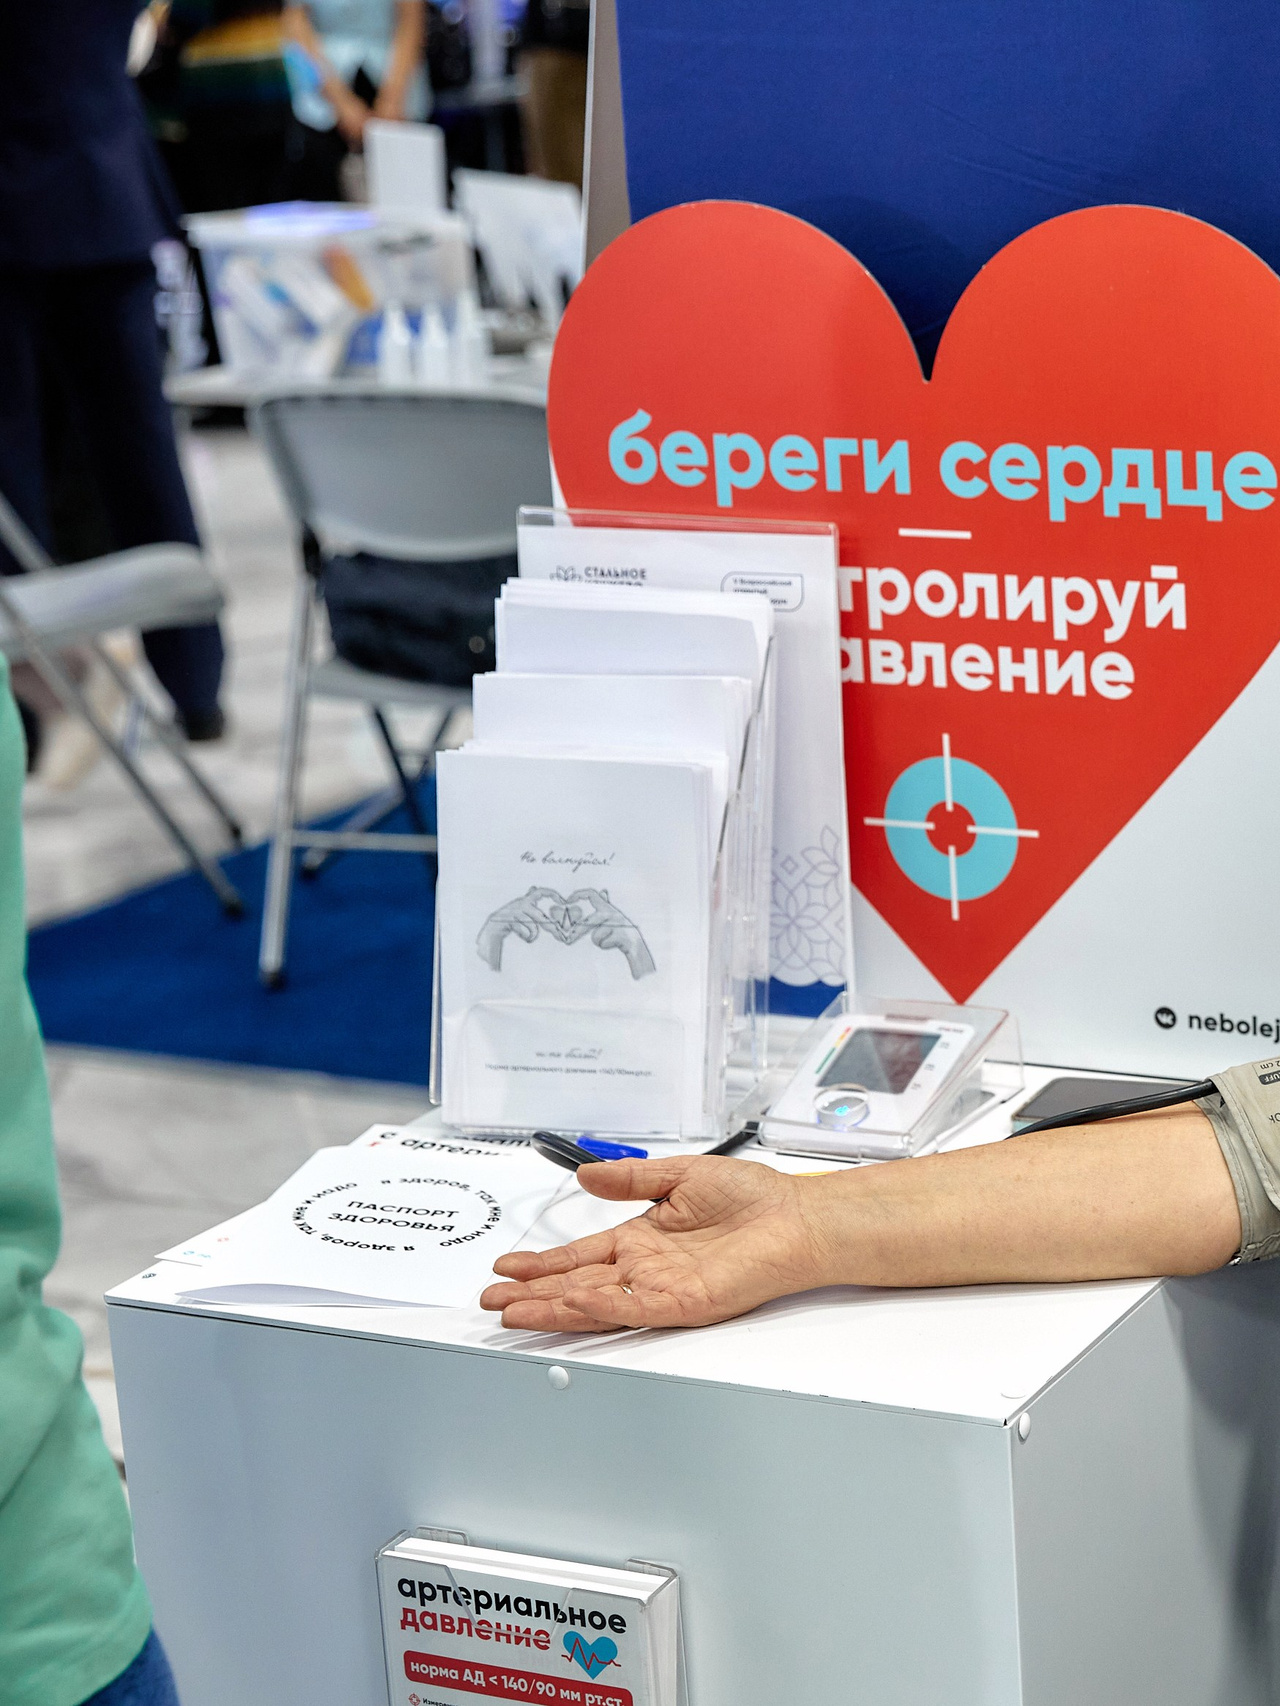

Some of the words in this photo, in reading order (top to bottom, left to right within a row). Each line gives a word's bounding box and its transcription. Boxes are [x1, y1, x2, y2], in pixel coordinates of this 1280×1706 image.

[608, 410, 912, 508] береги
[939, 440, 1279, 523] сердце
[583, 566, 647, 579] СТАЛЬНОЕ
[839, 564, 1187, 642] тролируй
[839, 635, 1135, 701] авление
[1259, 1062, 1274, 1070] cm
[295, 1220, 318, 1235] так
[312, 1182, 359, 1199] надо
[346, 1200, 461, 1219] ПАСПОРТ
[474, 1190, 499, 1205] так
[327, 1212, 457, 1233] ЗДОРОВЬЯ
[488, 1205, 503, 1223] мне
[438, 1230, 486, 1248] надо
[397, 1576, 628, 1635] артериальное
[400, 1607, 551, 1652] давление
[410, 1659, 460, 1681] норма
[462, 1668, 486, 1687] АД
[501, 1674, 556, 1698] 140/90
[559, 1689, 582, 1703] мм
